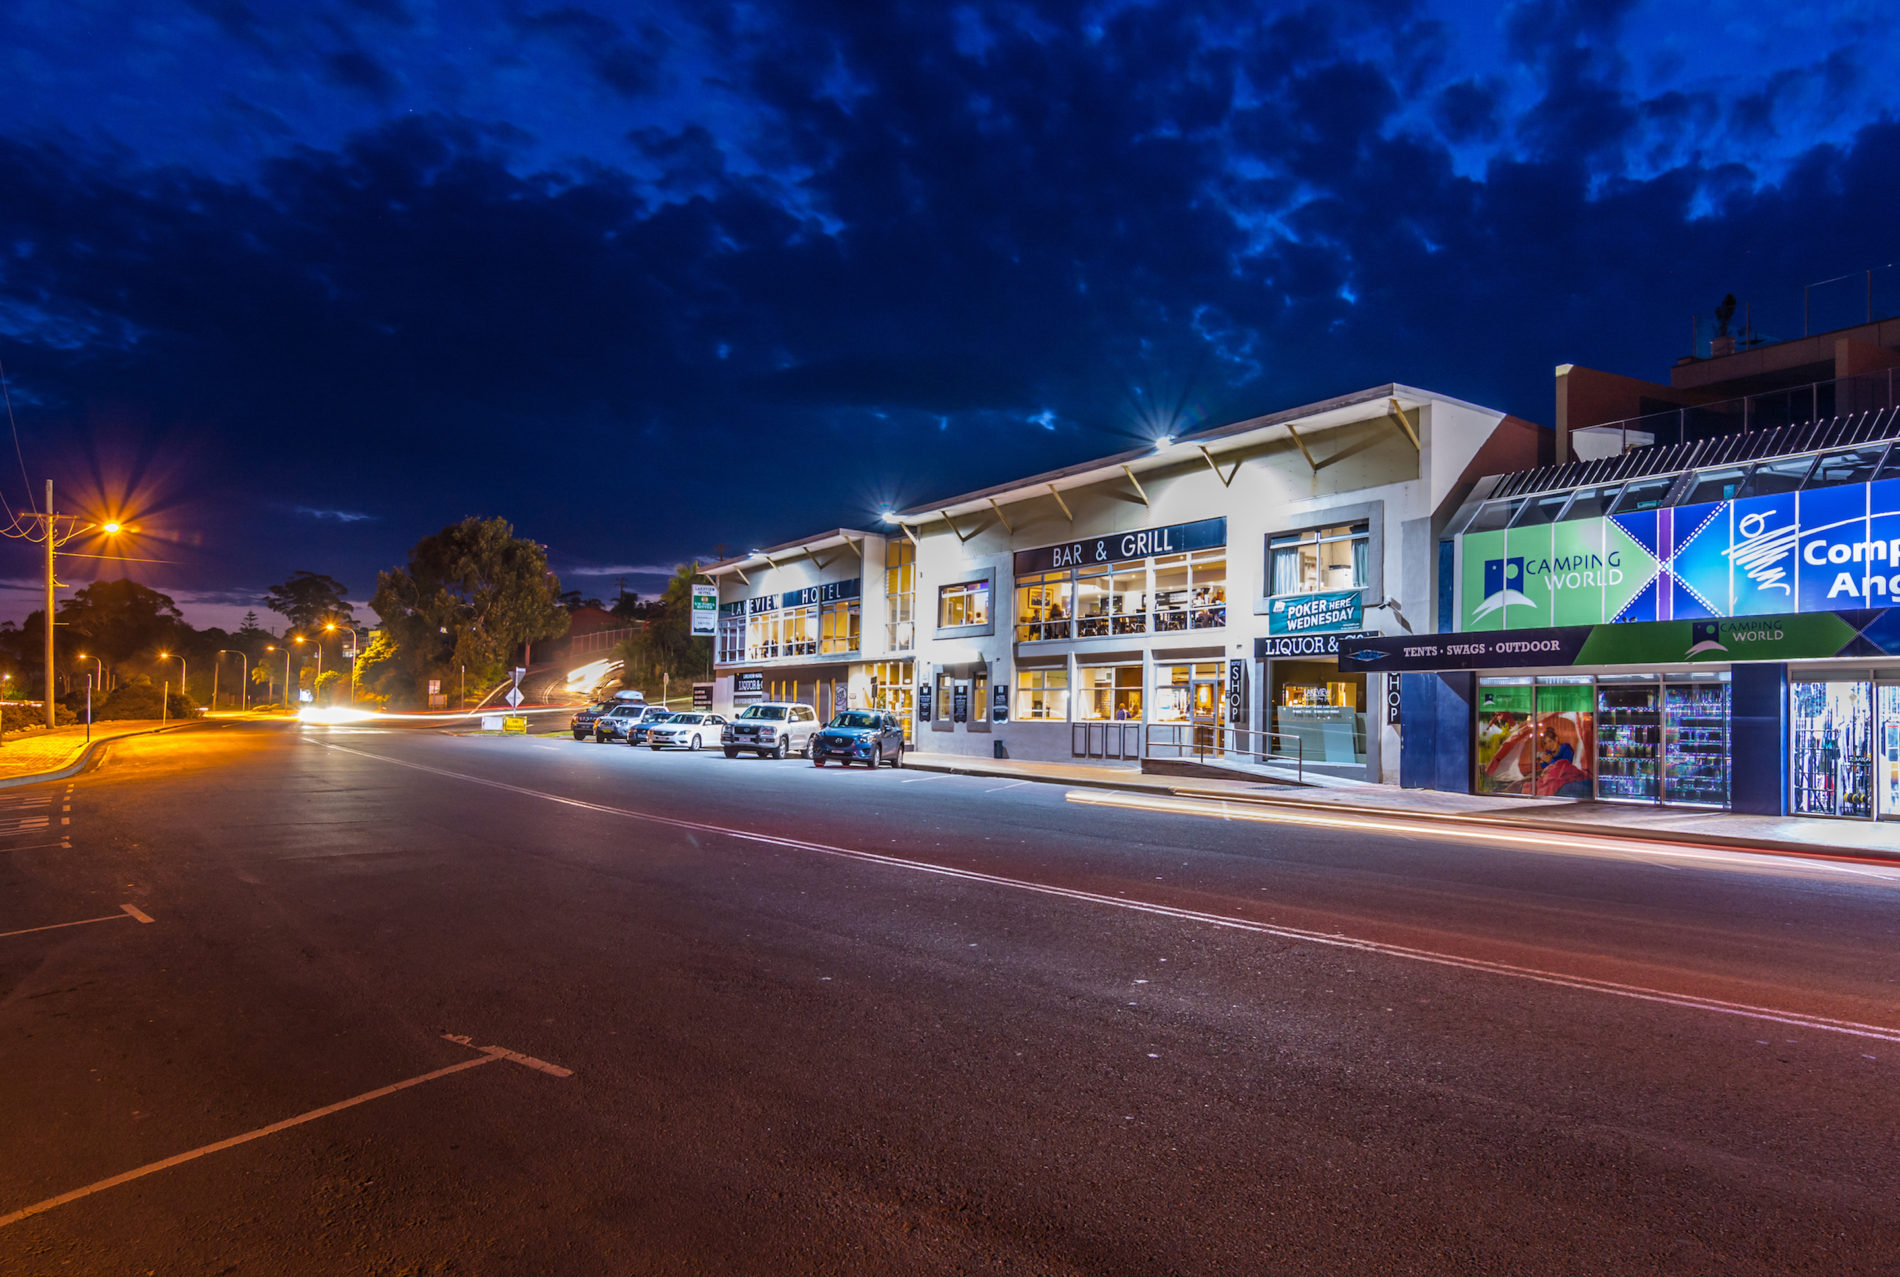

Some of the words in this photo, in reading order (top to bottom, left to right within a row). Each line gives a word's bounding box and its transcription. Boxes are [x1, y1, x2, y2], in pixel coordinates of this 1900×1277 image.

[1053, 544, 1083, 567] BAR
[1095, 540, 1107, 561] &
[1121, 529, 1173, 557] GRILL
[1526, 551, 1621, 575] CAMPING
[1544, 569, 1623, 590] WORLD
[802, 584, 840, 604] HOTEL
[1288, 599, 1327, 619] POKER
[1329, 597, 1352, 611] HERE
[1287, 606, 1355, 632] WEDNESDAY
[1720, 620, 1782, 632] CAMPING
[1265, 637, 1325, 656] LIQUOR
[1328, 636, 1339, 653] &
[1732, 630, 1784, 641] WORLD
[1404, 647, 1438, 657] TENTS
[1447, 643, 1485, 655] SWAGS
[1496, 640, 1560, 653] OUTDOOR
[1230, 666, 1240, 720] SHOP
[1389, 672, 1401, 722] HOP
